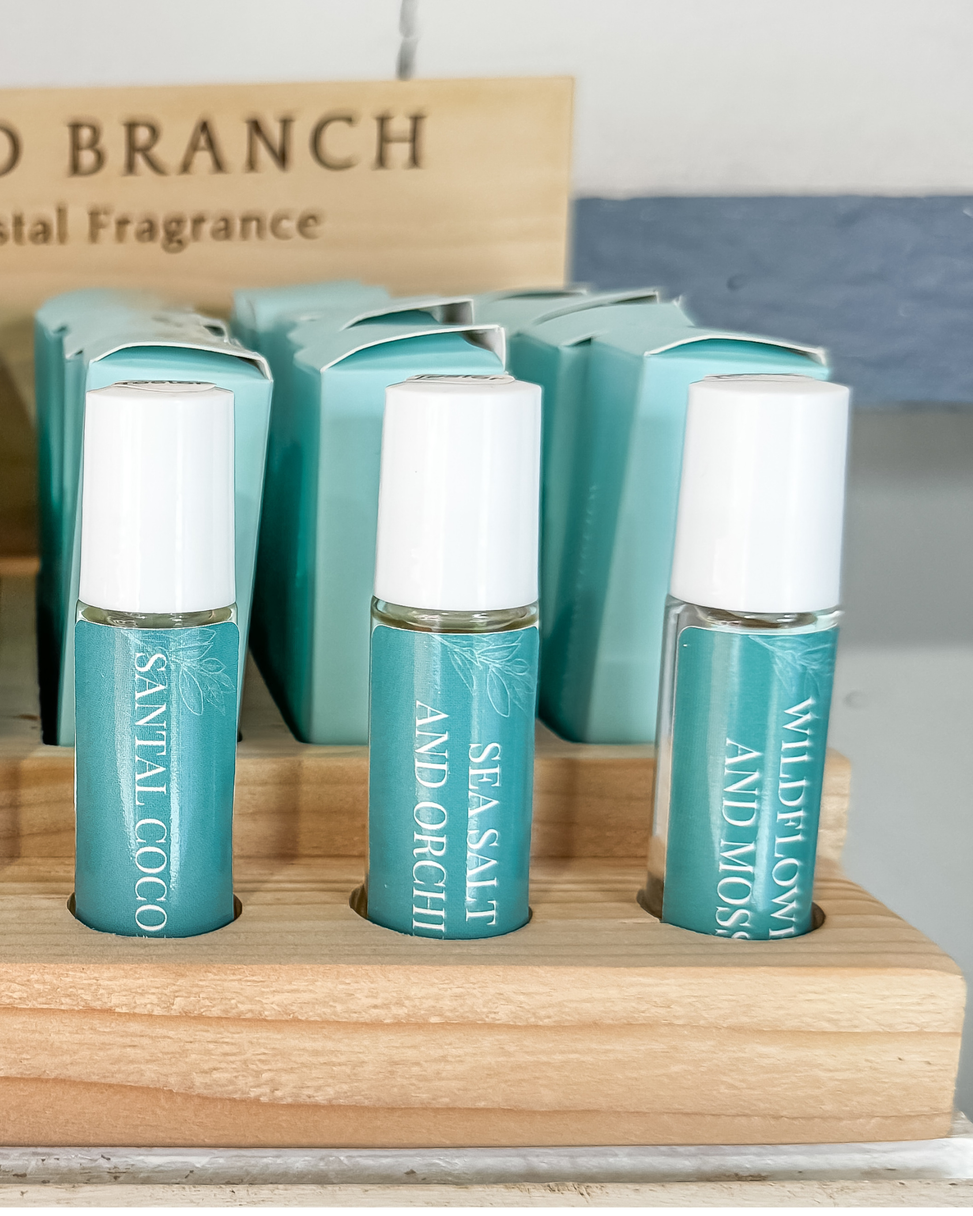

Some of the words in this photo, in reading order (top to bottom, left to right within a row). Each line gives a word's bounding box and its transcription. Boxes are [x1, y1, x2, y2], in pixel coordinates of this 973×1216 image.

[65, 105, 429, 178] BRANCH
[87, 202, 325, 254] Fragrance
[133, 651, 168, 806] SANTAL
[414, 701, 448, 788] AND
[467, 741, 502, 819] SEA
[722, 737, 761, 828] AND
[412, 802, 448, 939] ORCHI
[465, 829, 500, 926] SALT
